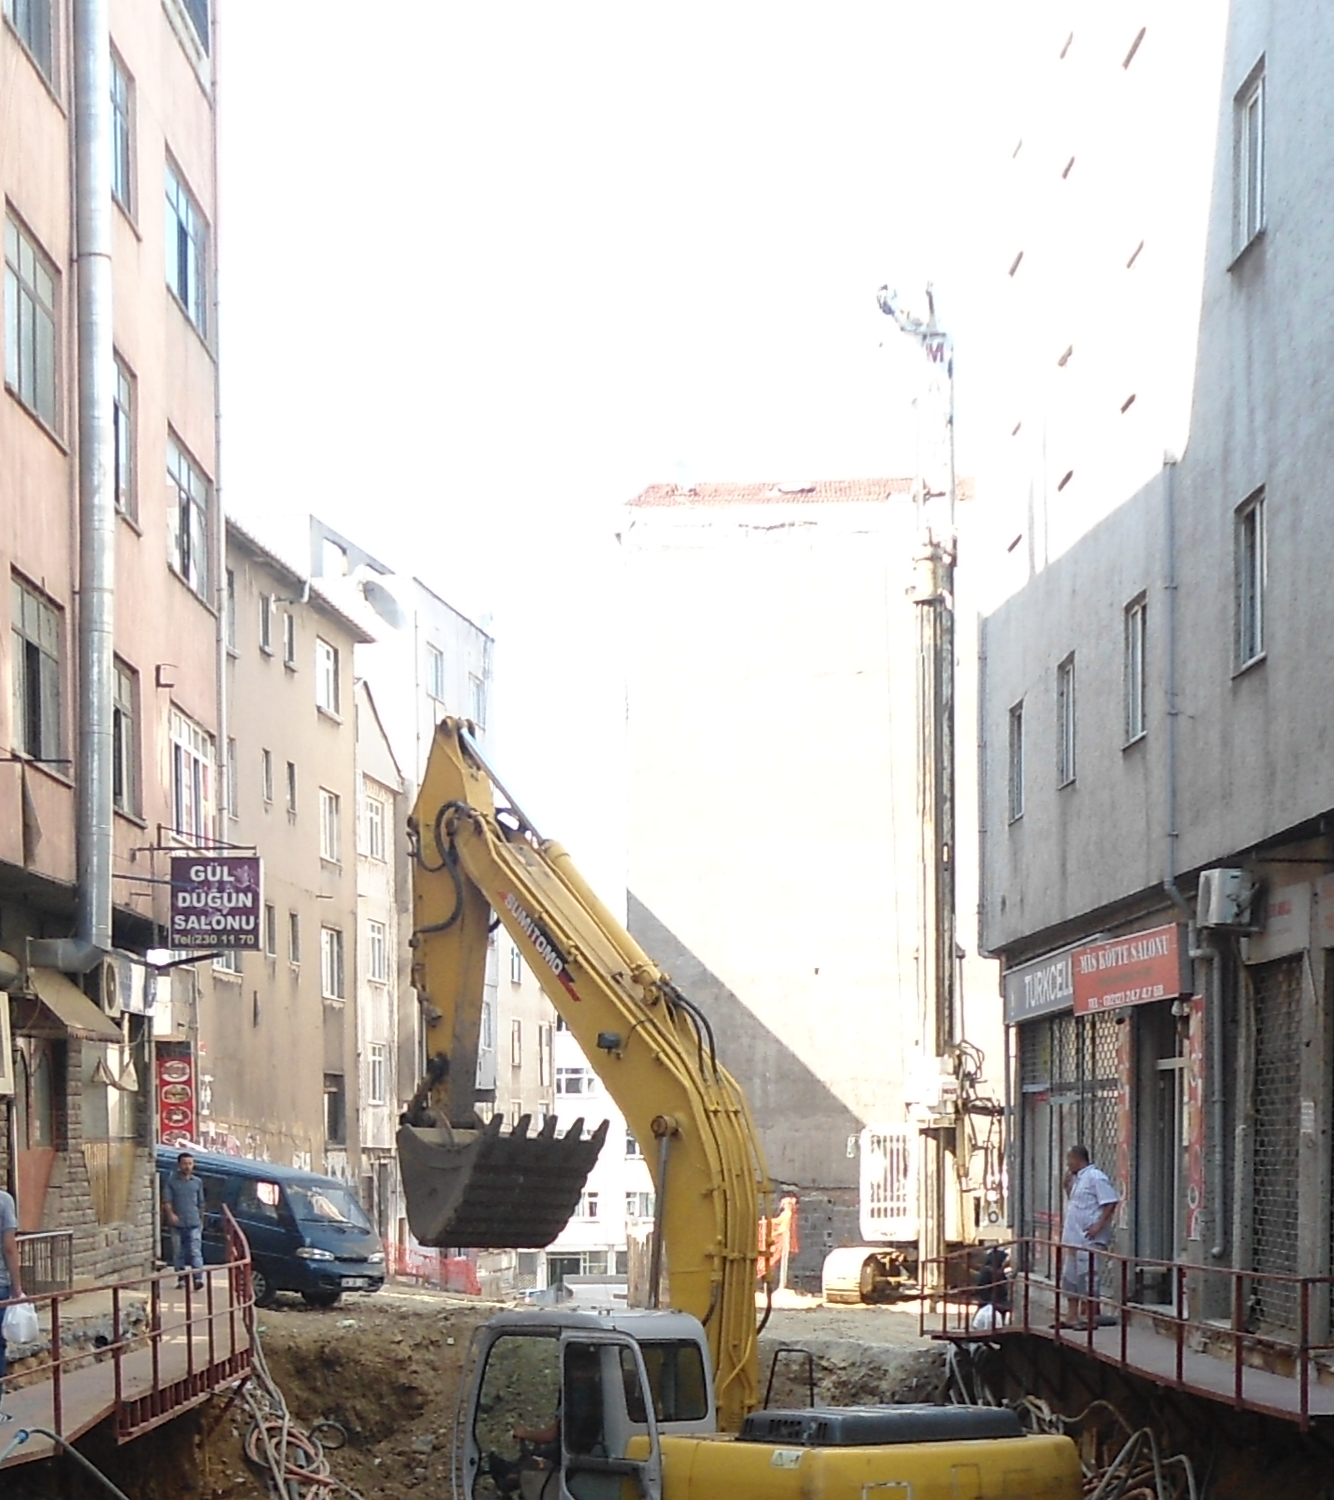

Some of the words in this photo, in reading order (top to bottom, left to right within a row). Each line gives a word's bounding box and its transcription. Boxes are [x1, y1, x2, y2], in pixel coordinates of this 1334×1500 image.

[189, 862, 235, 882] GÜL
[177, 888, 253, 908] DÜĞÜN
[173, 915, 255, 931] SALONU
[221, 934, 235, 945] 11
[239, 934, 255, 945] 70
[504, 893, 564, 976] SUMITOMO
[1078, 948, 1097, 974] MİS
[1099, 944, 1129, 970] KÖFTE
[1131, 934, 1170, 963] SALONU
[1024, 956, 1073, 1009] TURKCELL
[1126, 989, 1140, 1004] 247
